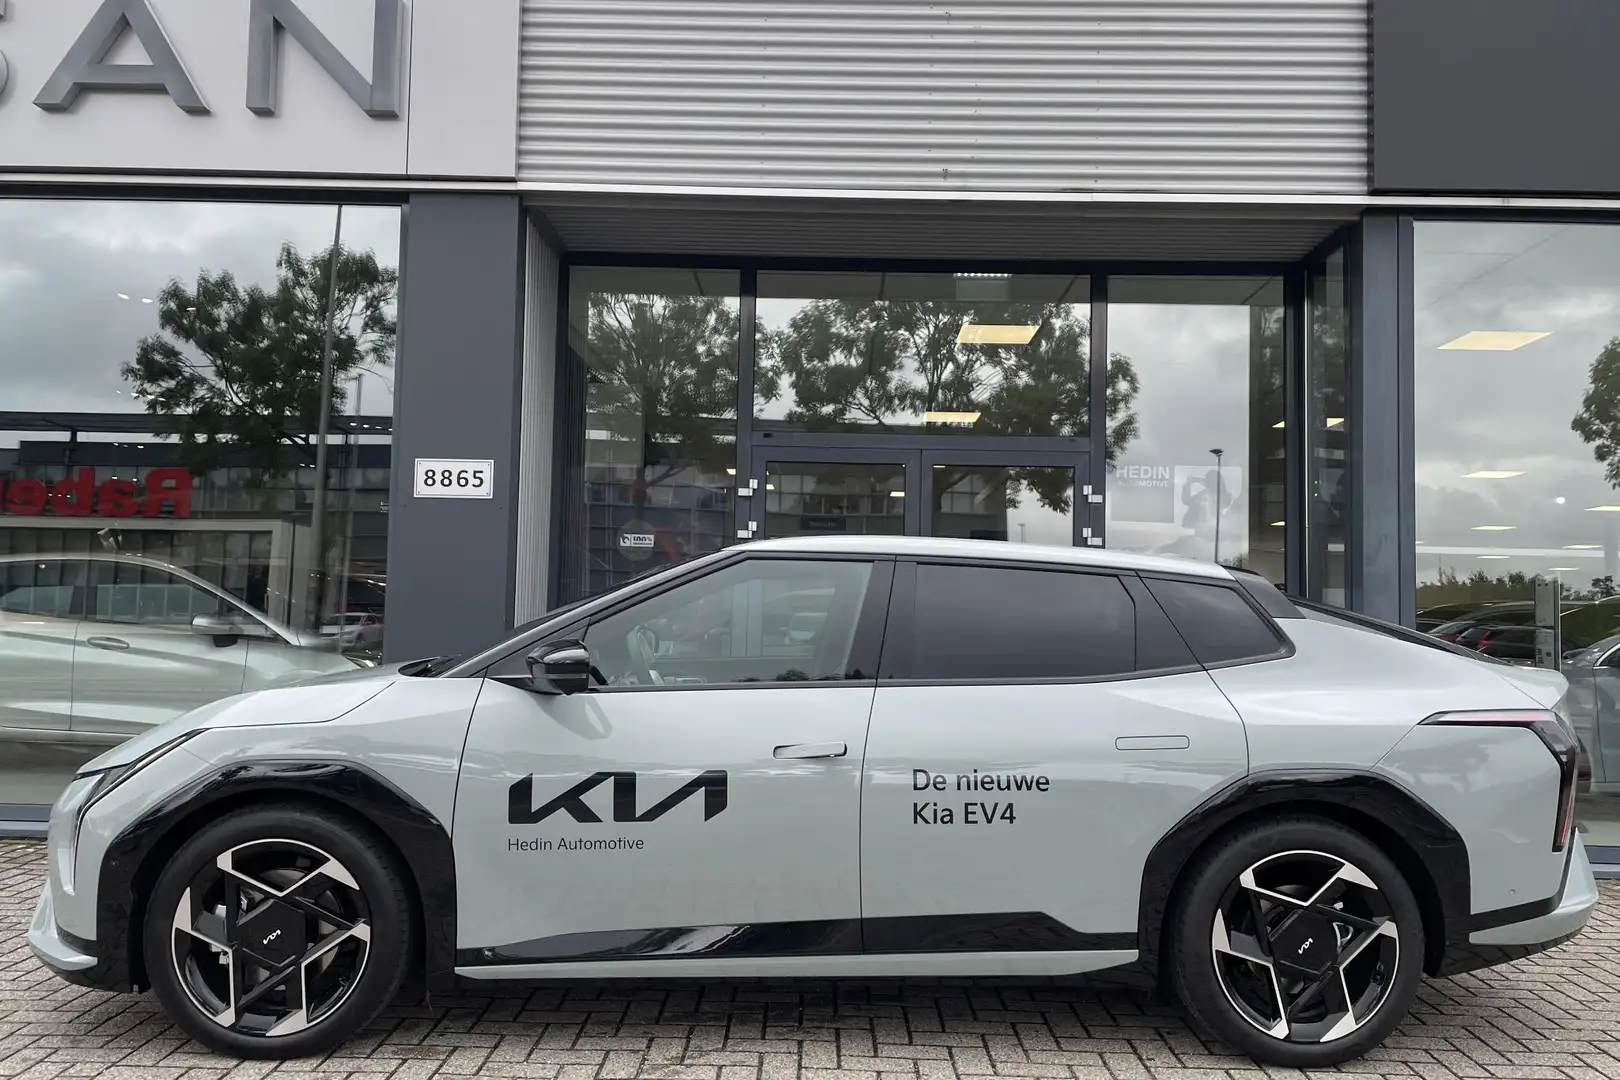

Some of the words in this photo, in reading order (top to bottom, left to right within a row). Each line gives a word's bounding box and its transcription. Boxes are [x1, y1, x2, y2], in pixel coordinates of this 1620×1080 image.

[0, 0, 401, 119] AN
[423, 469, 484, 488] 8865
[1116, 465, 1170, 479] HEDIN
[913, 769, 947, 791] De
[956, 769, 1050, 792] nieuwe
[508, 770, 728, 824] KIA
[913, 802, 954, 824] Kia
[964, 802, 1016, 824] EV4
[507, 838, 552, 851] Hedin
[557, 837, 644, 850] Automotive
